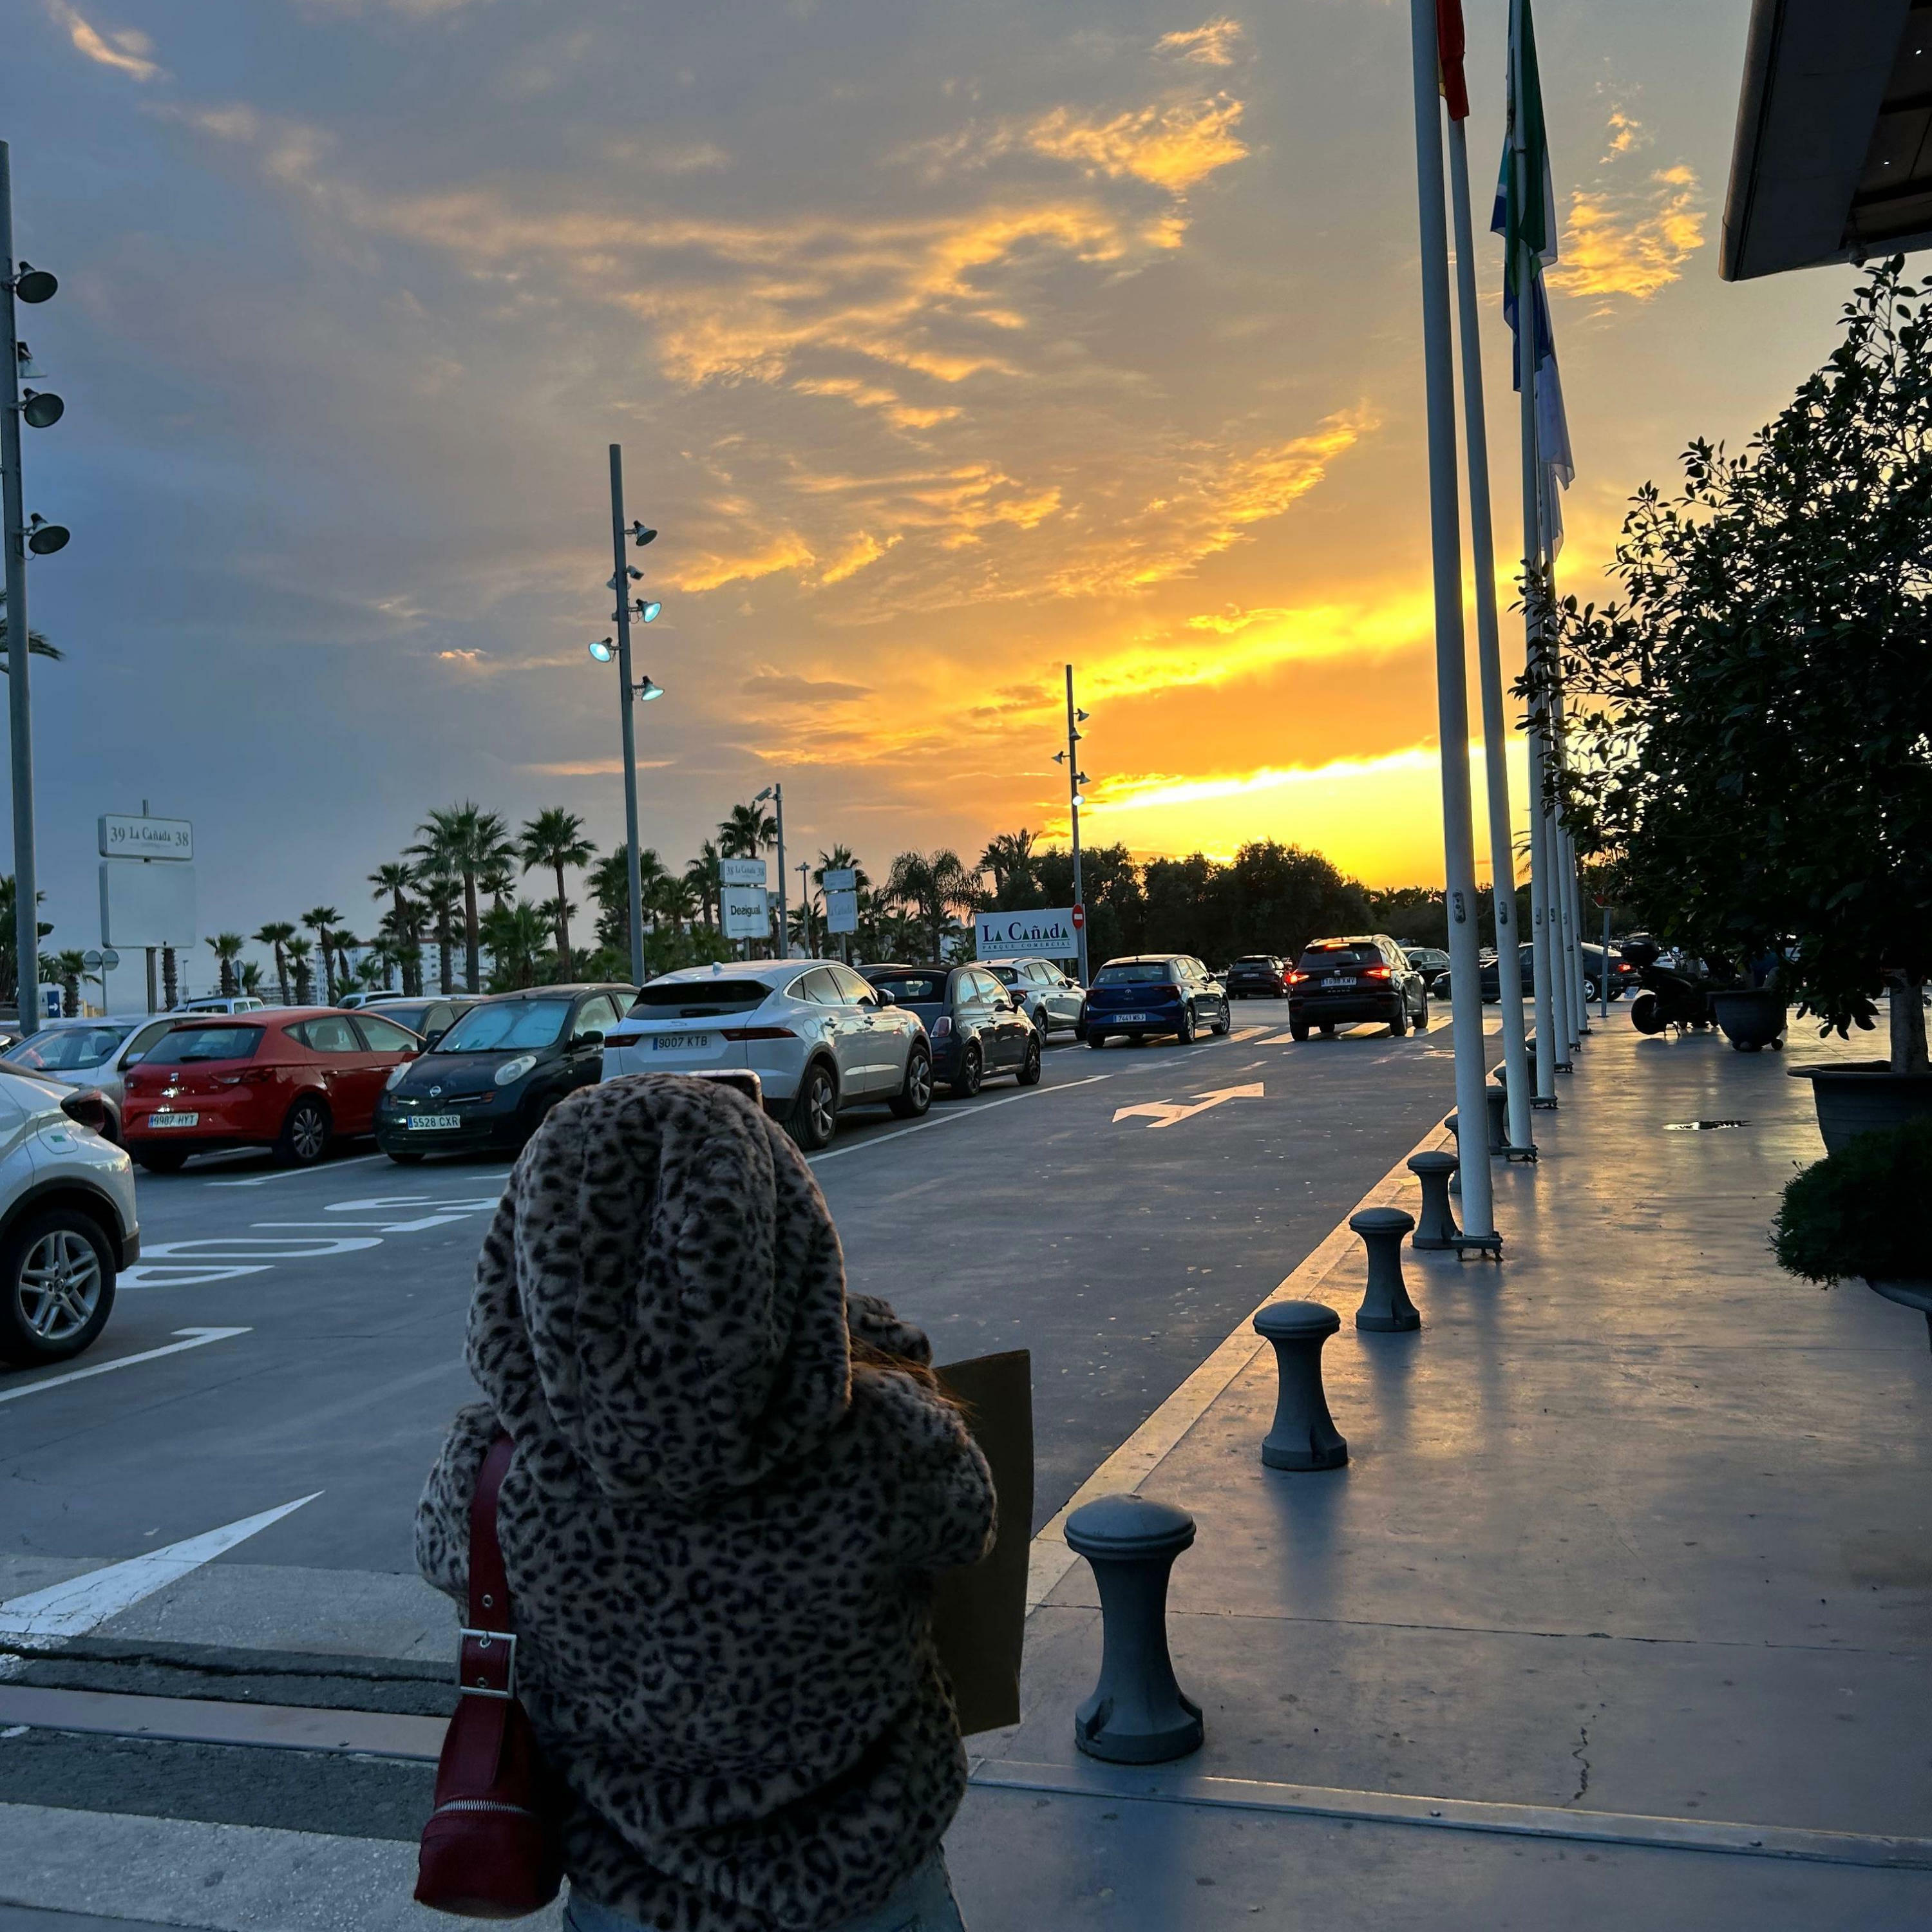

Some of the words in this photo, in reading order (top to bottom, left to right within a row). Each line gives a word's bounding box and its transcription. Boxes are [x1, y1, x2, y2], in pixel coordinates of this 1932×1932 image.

[110, 826, 126, 843] 39
[175, 831, 189, 847] 38
[659, 1037, 685, 1048] 9007
[687, 1036, 708, 1046] KTB
[178, 1115, 195, 1125] HYT
[413, 1117, 436, 1128] 5528
[439, 1117, 459, 1127] CXR
